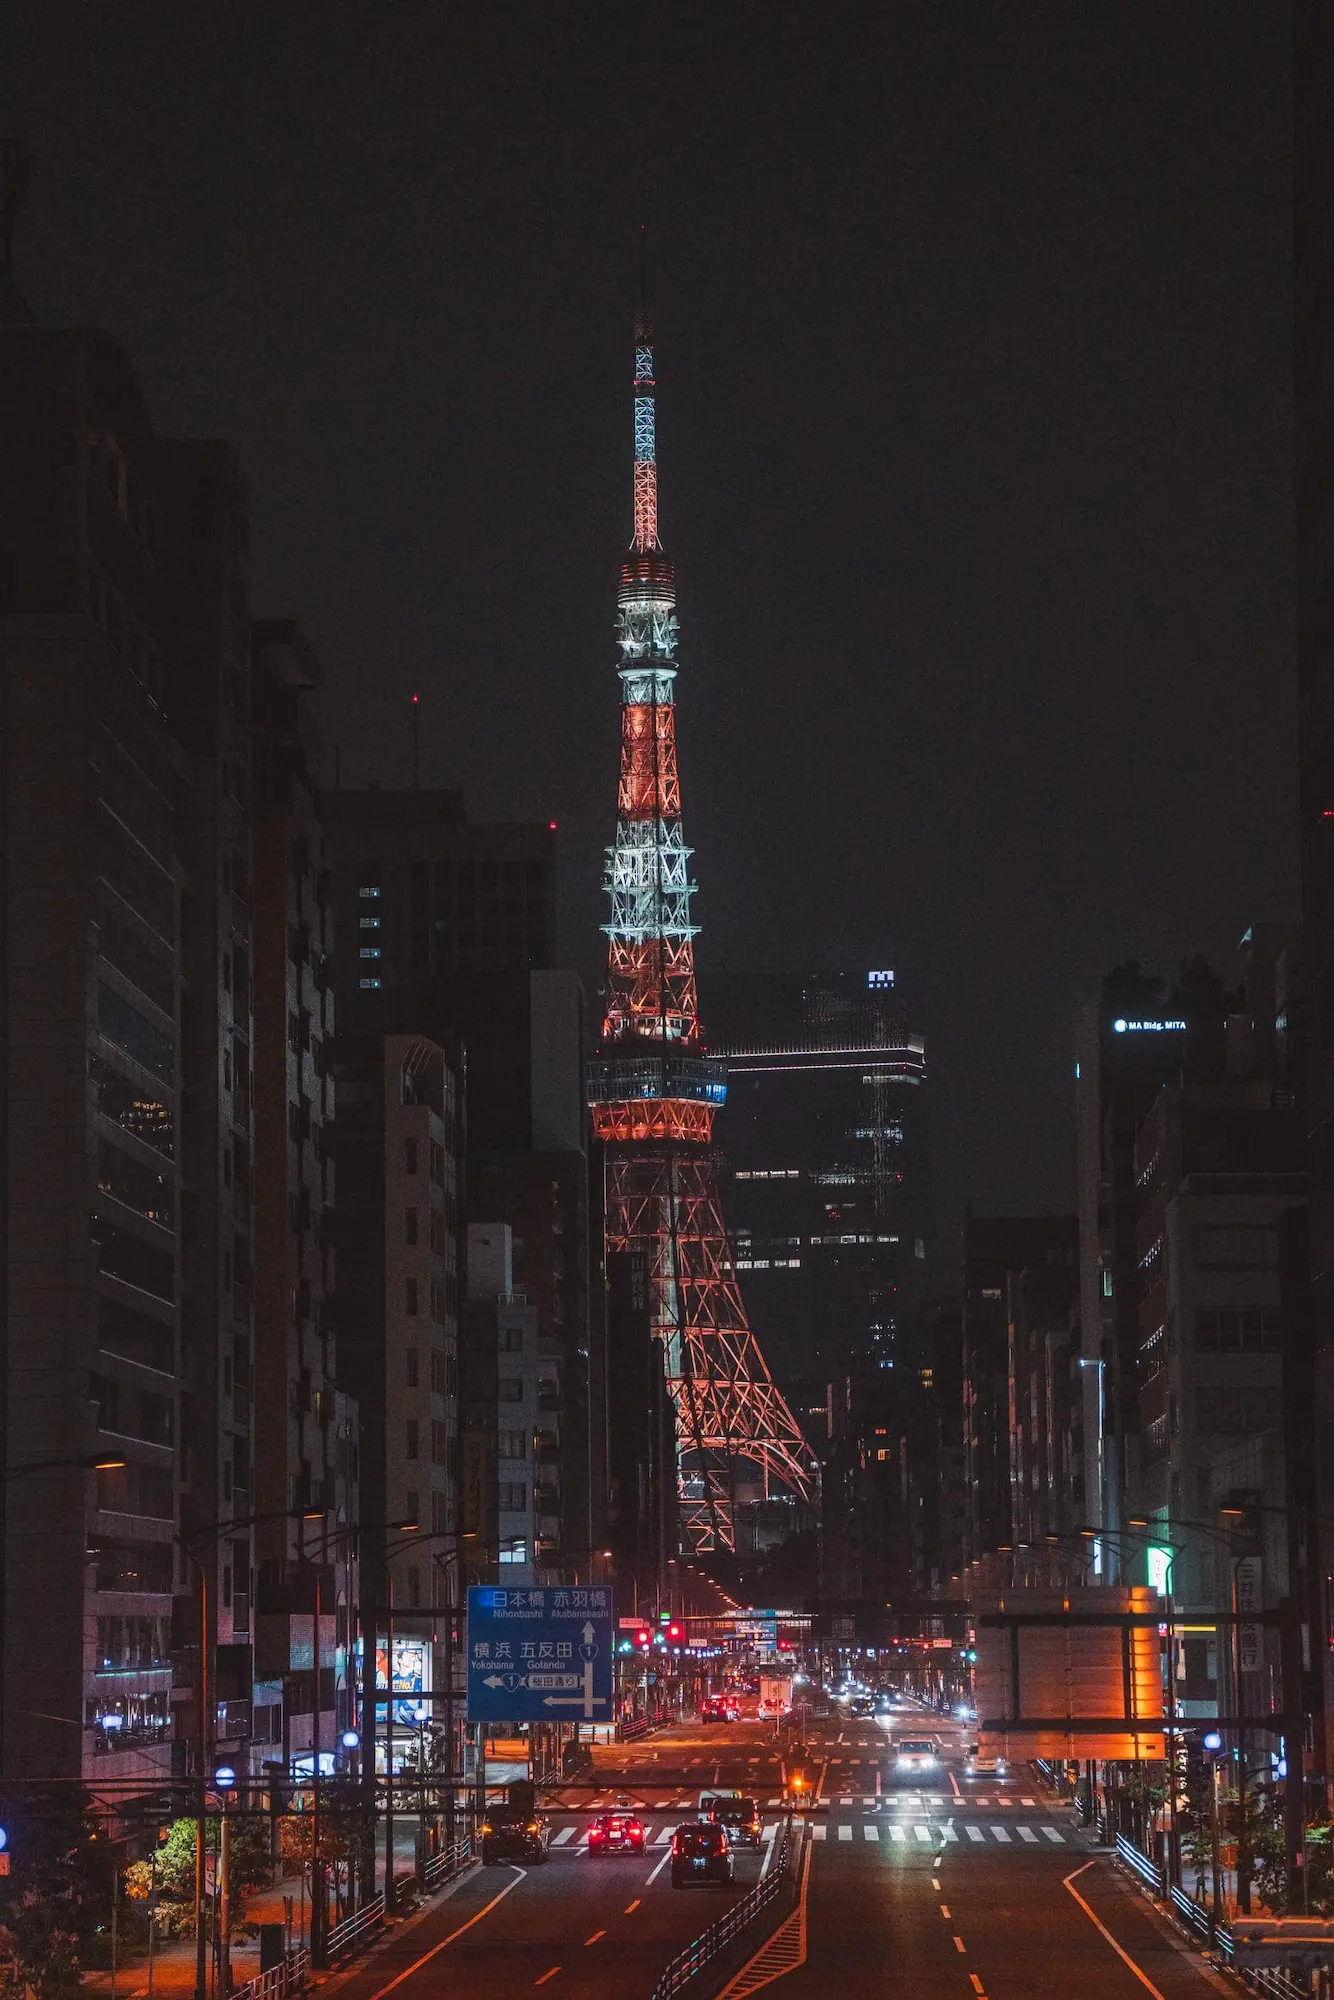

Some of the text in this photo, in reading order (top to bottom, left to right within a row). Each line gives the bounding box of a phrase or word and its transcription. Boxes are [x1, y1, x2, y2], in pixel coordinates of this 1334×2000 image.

[1129, 1020, 1186, 1031] MA Bldg. MITA
[493, 1591, 606, 1607] 日本橋 赤羽橋
[493, 1609, 608, 1618] Nihonbashi Akabanebashi
[473, 1642, 572, 1658] 横浜 五反田
[585, 1646, 591, 1657] 1
[471, 1660, 565, 1670] Yokohama Gotanda
[508, 1676, 514, 1686] 1
[532, 1676, 575, 1687] 桜田通り
